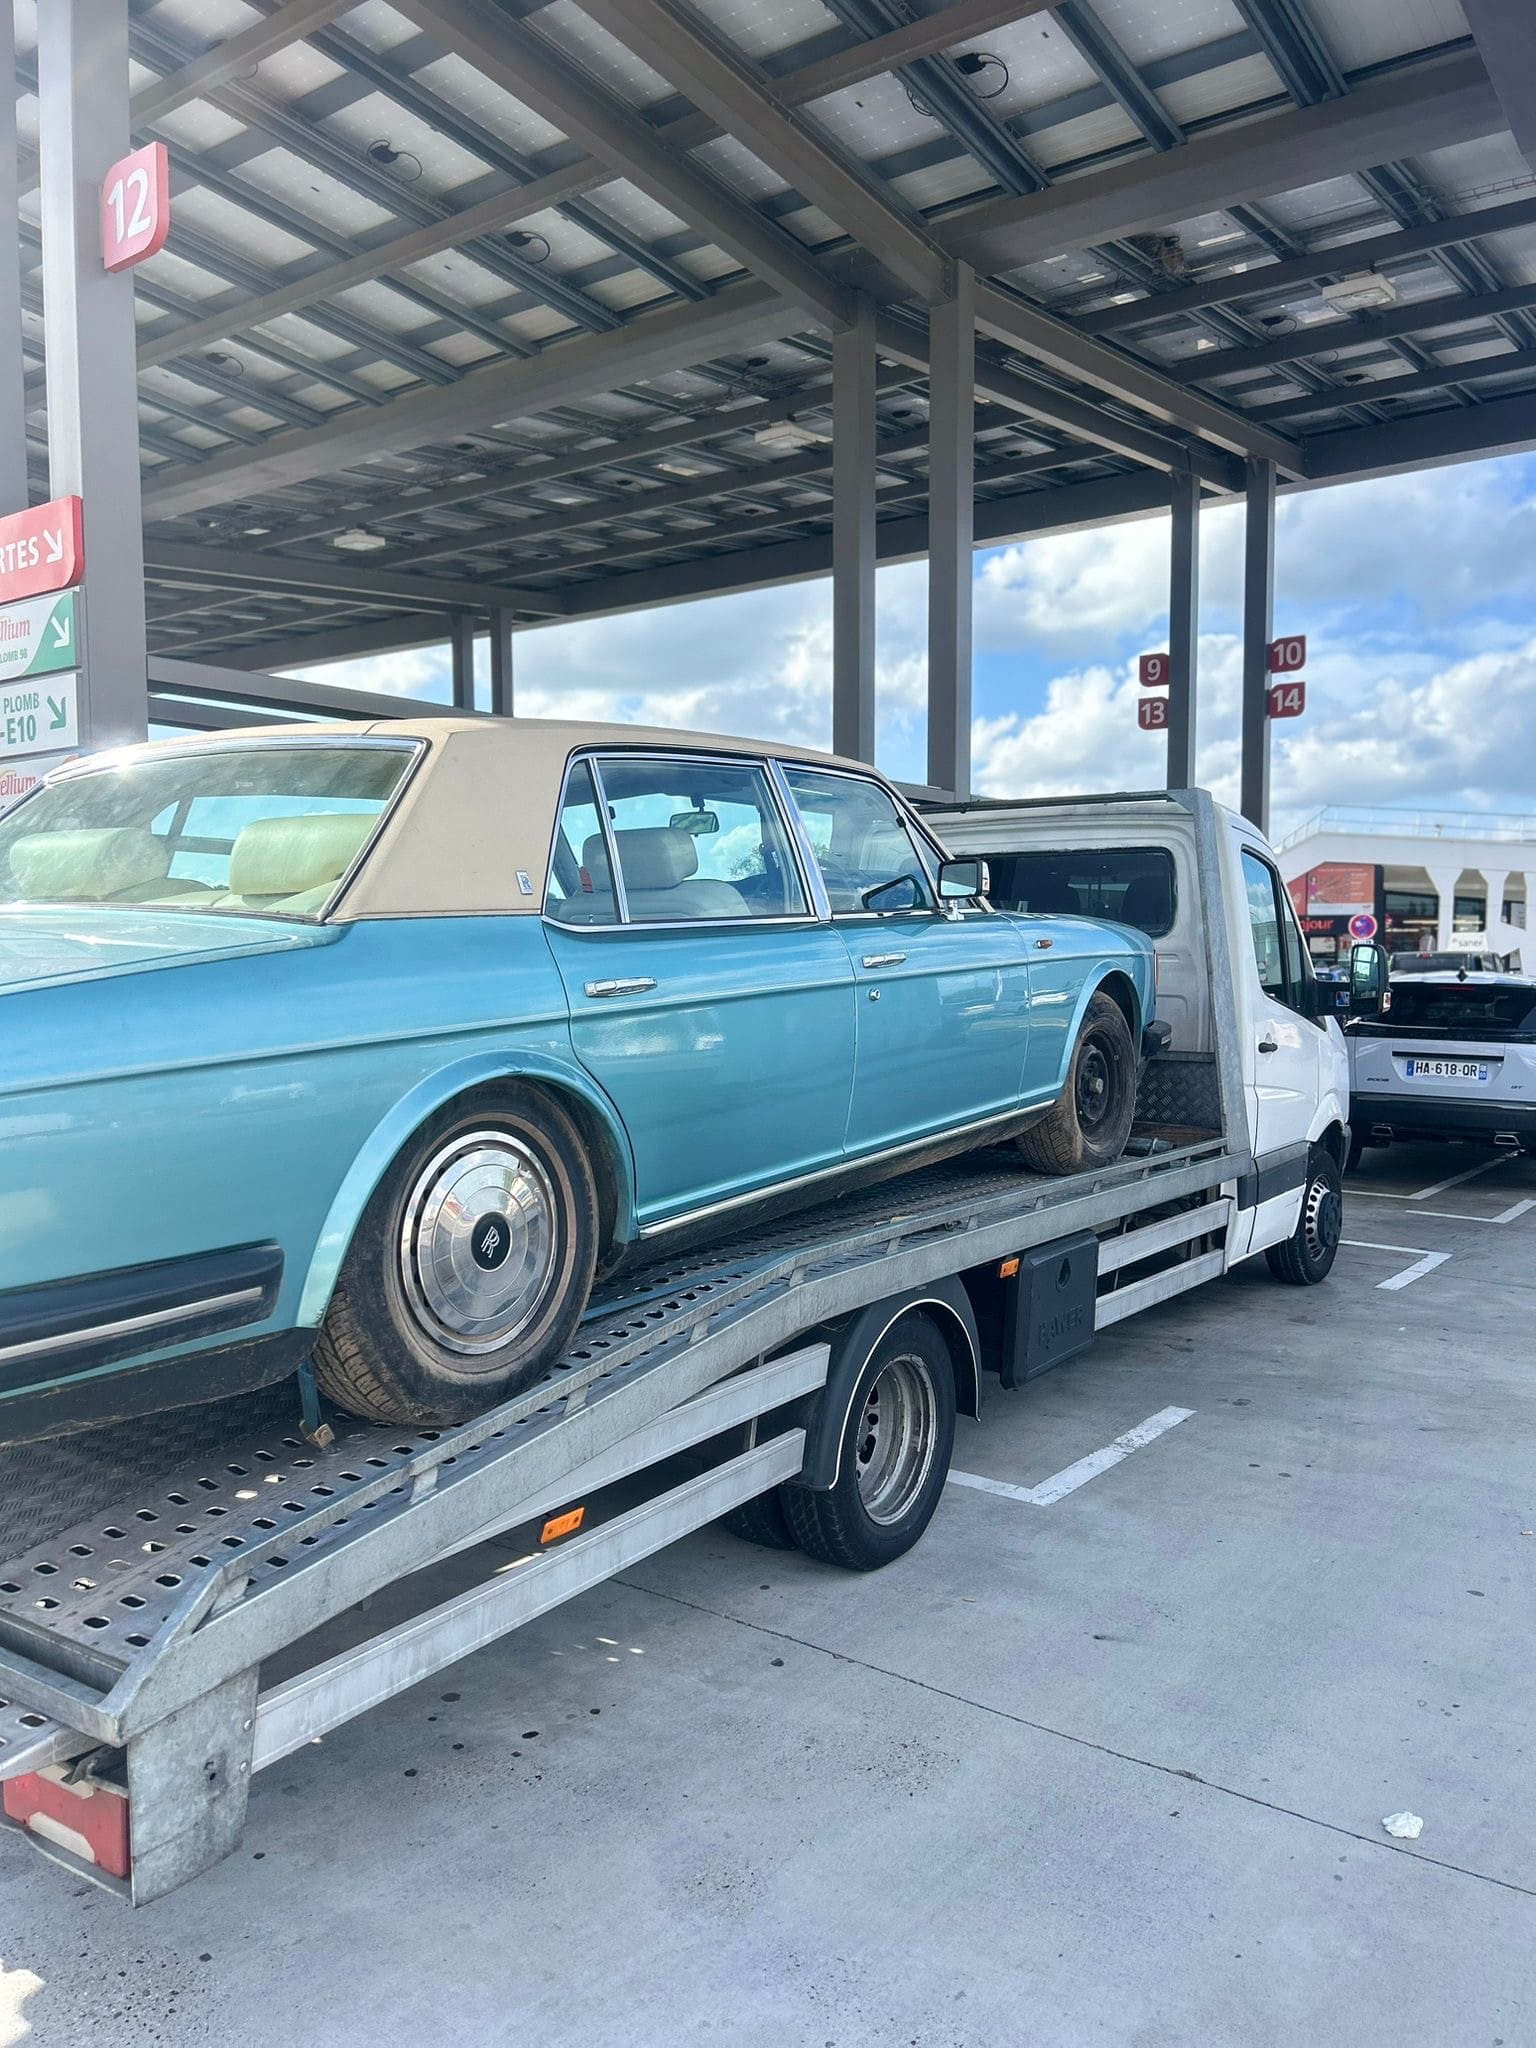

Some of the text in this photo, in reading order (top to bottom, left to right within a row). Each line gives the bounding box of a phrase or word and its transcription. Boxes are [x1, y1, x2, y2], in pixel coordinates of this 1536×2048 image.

[107, 167, 152, 244] 12
[1274, 641, 1302, 667] 10
[1147, 658, 1161, 681] 9
[4, 692, 40, 715] PLOMB
[1272, 688, 1301, 713] 14
[1141, 701, 1165, 725] 13
